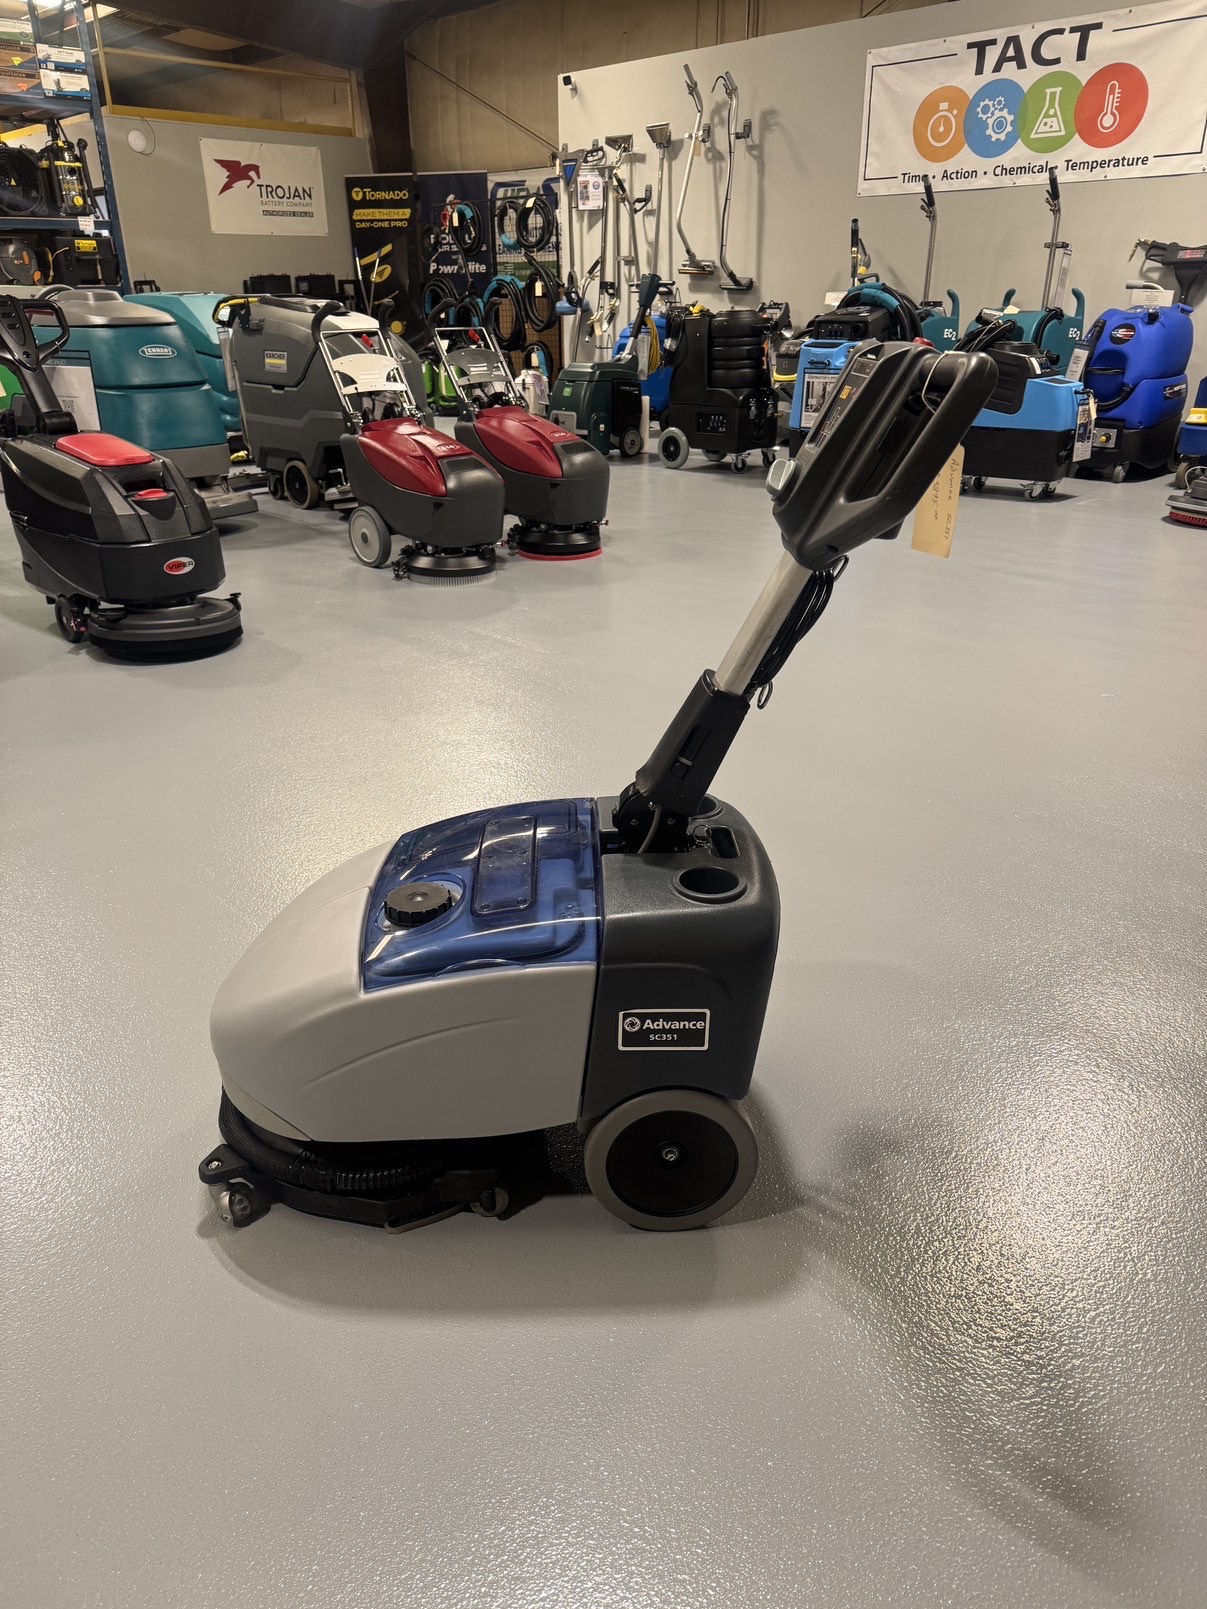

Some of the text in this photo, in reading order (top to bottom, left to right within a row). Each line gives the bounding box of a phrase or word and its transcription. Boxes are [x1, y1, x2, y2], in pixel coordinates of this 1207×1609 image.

[967, 22, 1103, 75] TACT
[941, 168, 978, 181] Action
[993, 161, 1048, 177] Chemical
[1064, 155, 1149, 172] Temperature
[257, 184, 313, 200] TROJAN
[363, 188, 408, 200] TORNADO
[168, 560, 193, 570] VIPER
[643, 1018, 705, 1030] Advance
[649, 1033, 678, 1041] SC351
